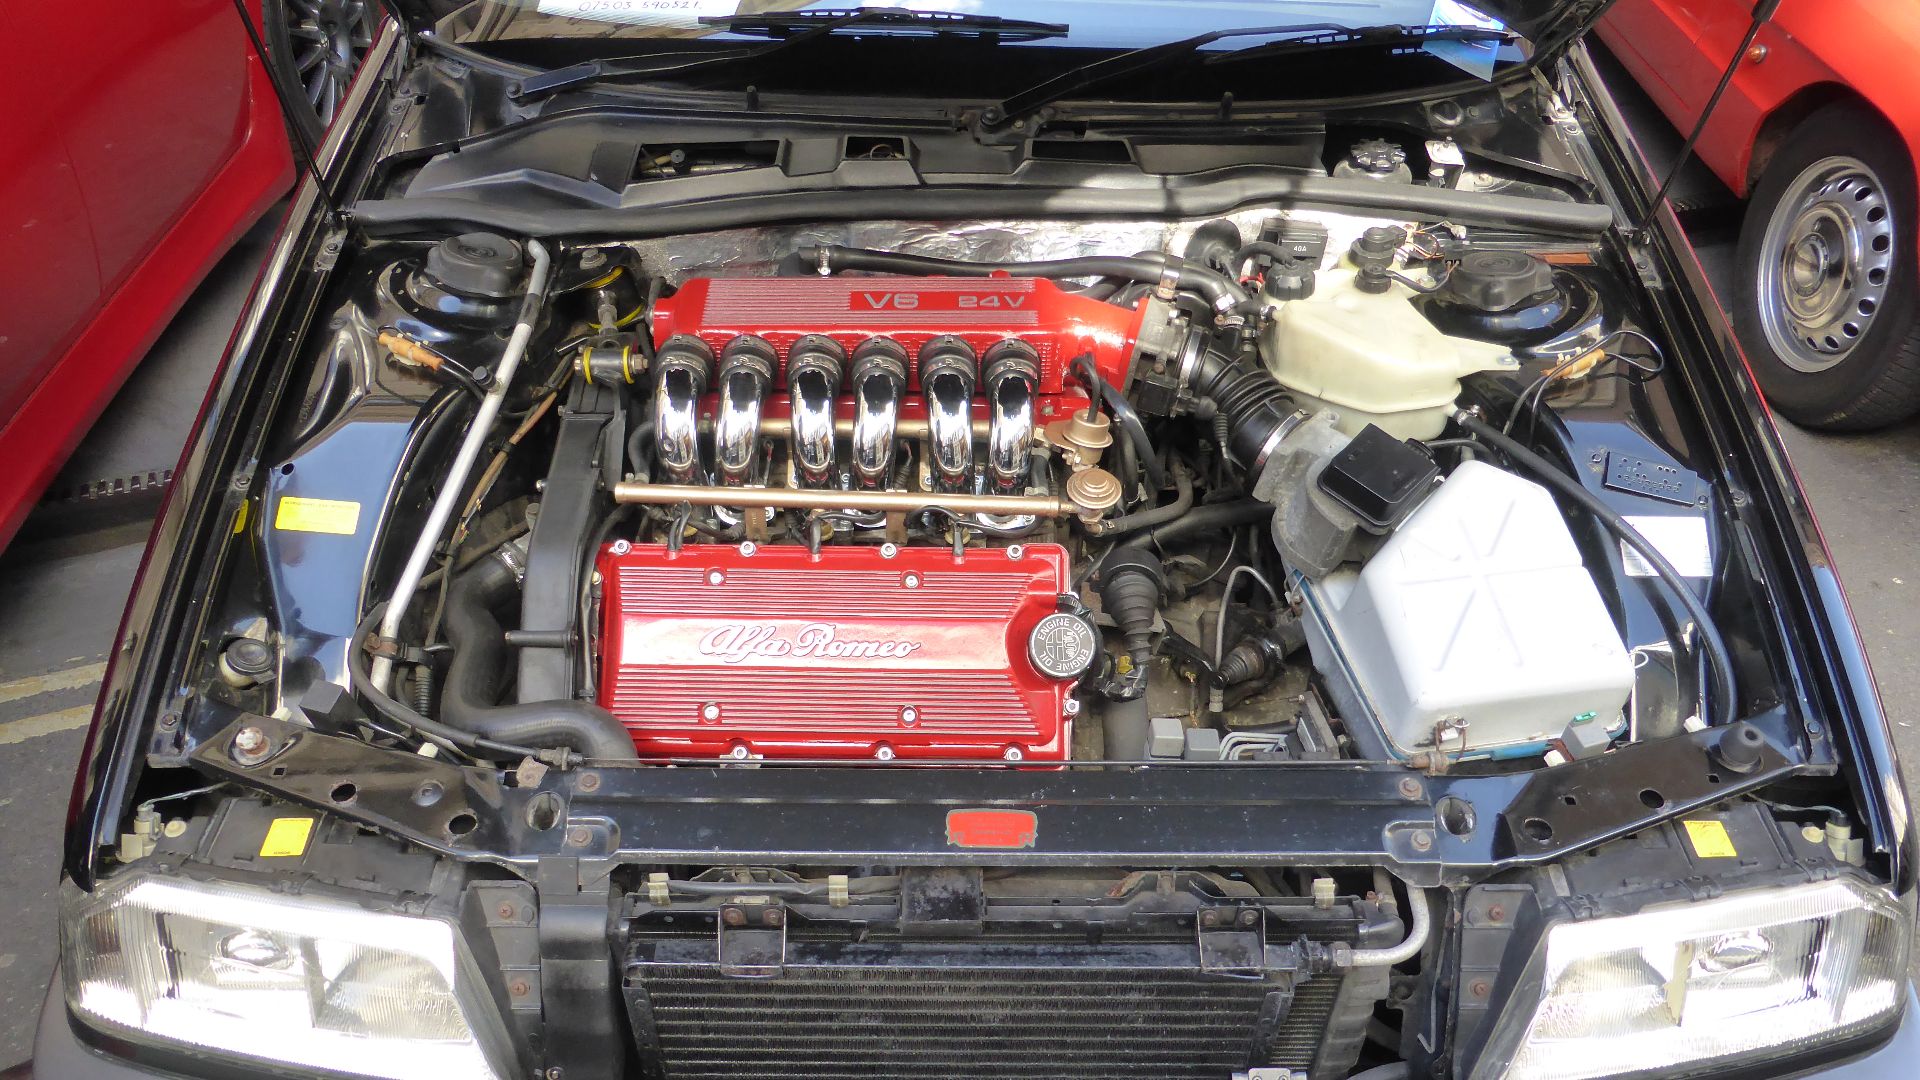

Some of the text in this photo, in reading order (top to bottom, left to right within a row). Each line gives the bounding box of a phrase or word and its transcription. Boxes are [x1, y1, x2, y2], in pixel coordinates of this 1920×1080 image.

[863, 293, 1025, 309] V6 24V
[1037, 617, 1087, 641] ENGINE OIL
[699, 622, 922, 664] Alfa Romeo
[1039, 648, 1089, 672] ENGINE OIL
